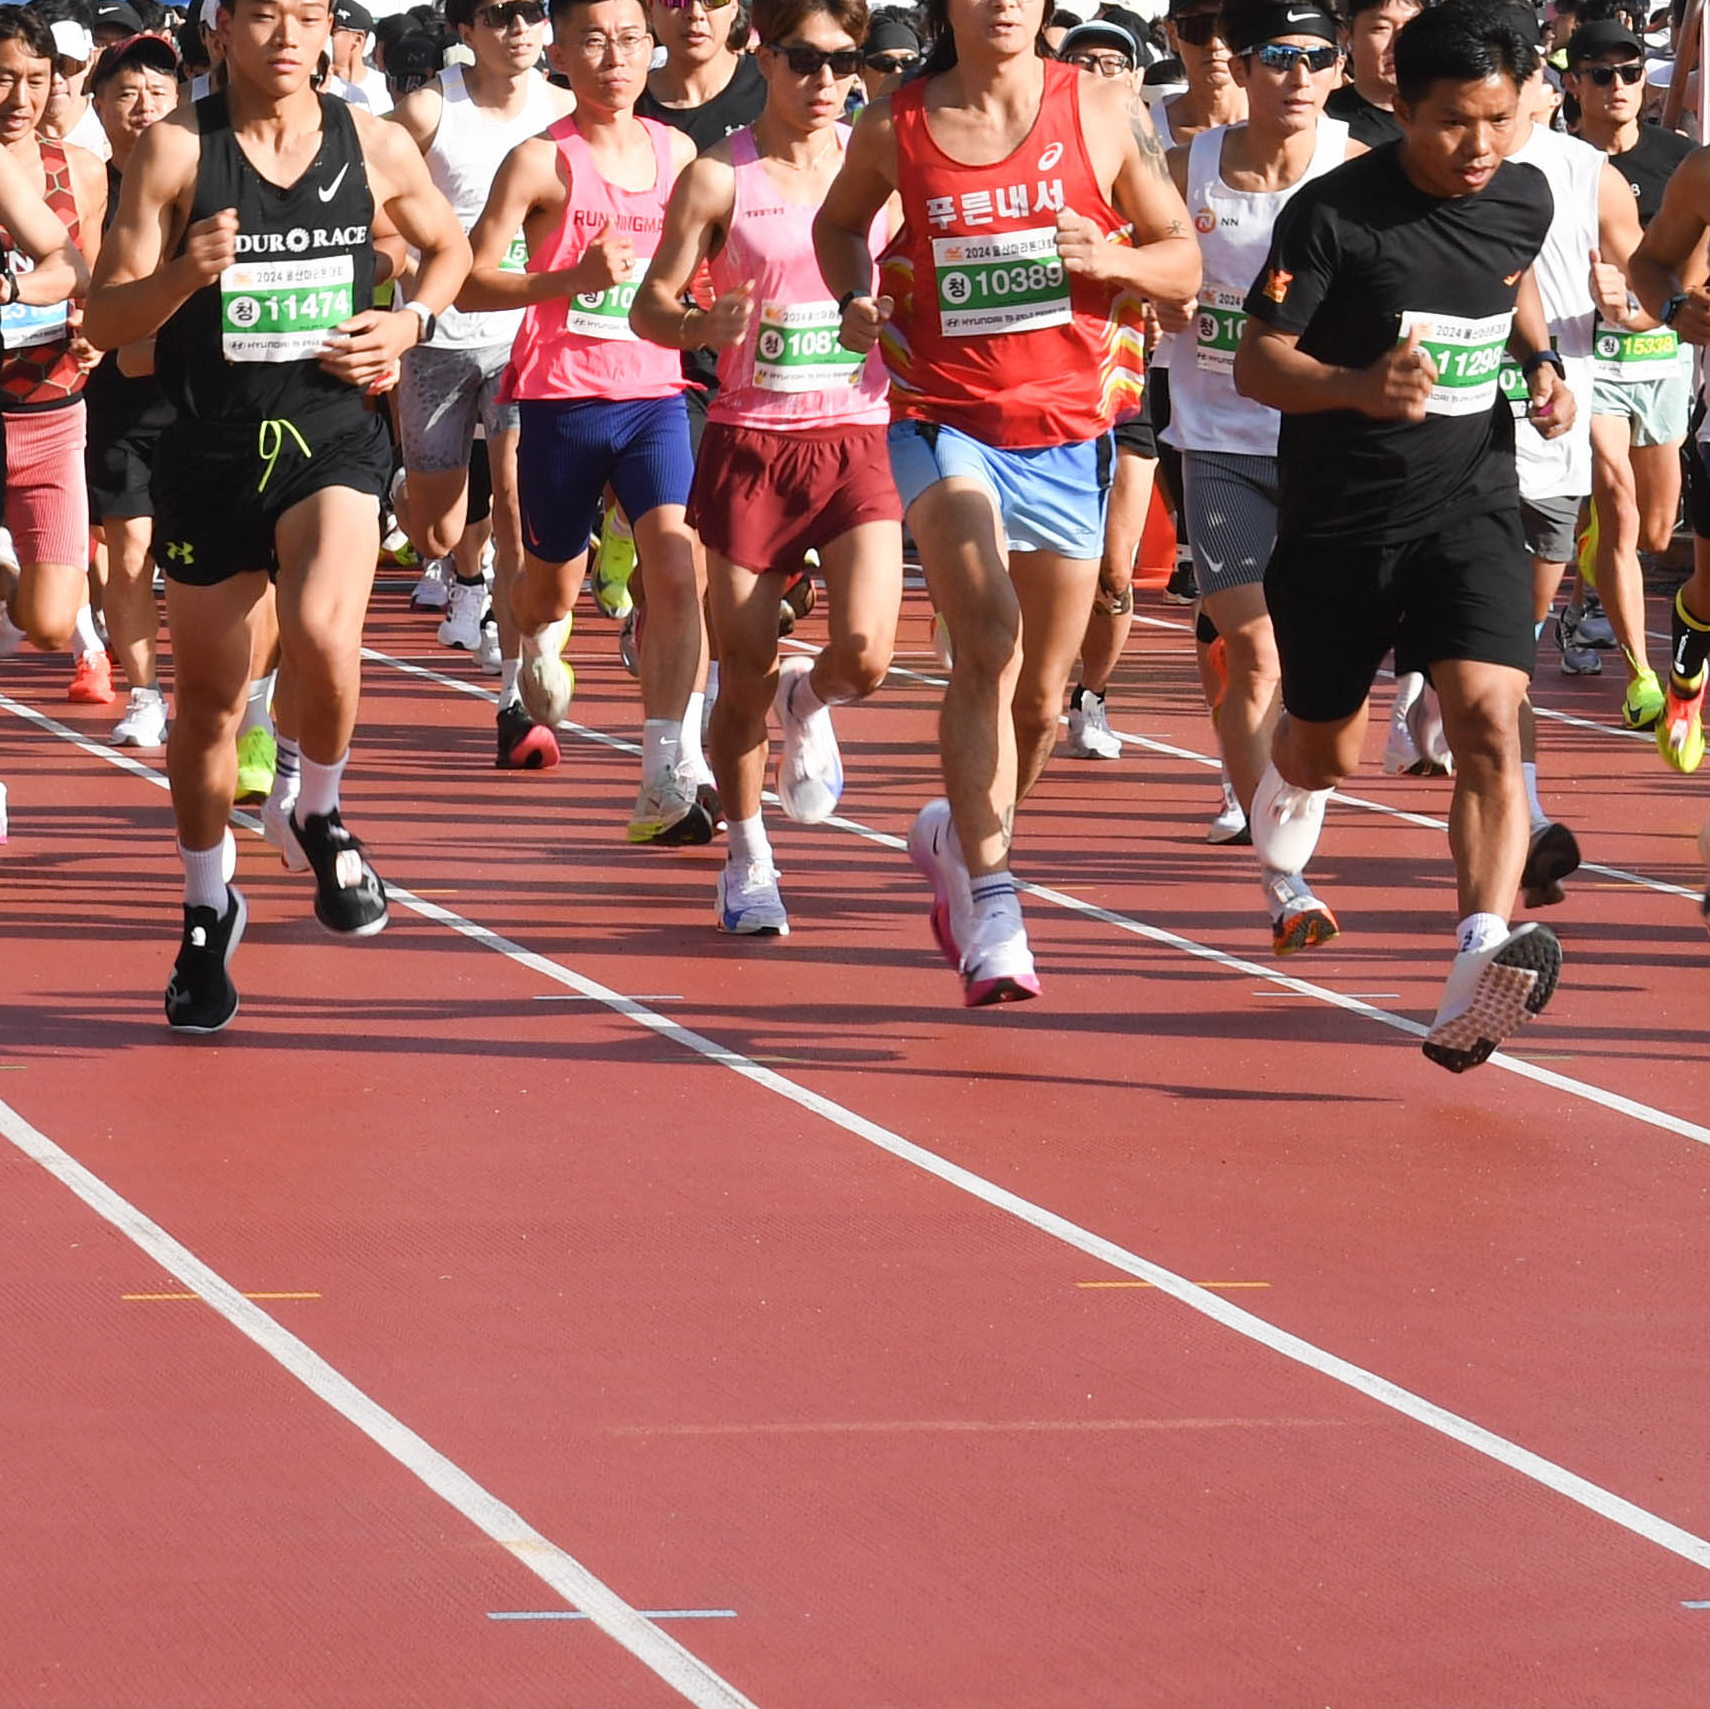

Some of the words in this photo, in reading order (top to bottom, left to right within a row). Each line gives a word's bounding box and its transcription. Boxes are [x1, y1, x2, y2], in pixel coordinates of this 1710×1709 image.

[1221, 217, 1239, 227] NN
[312, 226, 367, 248] RACE
[965, 247, 990, 259] 2024
[257, 272, 283, 283] 2024
[975, 262, 1064, 296] 10389
[265, 289, 349, 321] 11474
